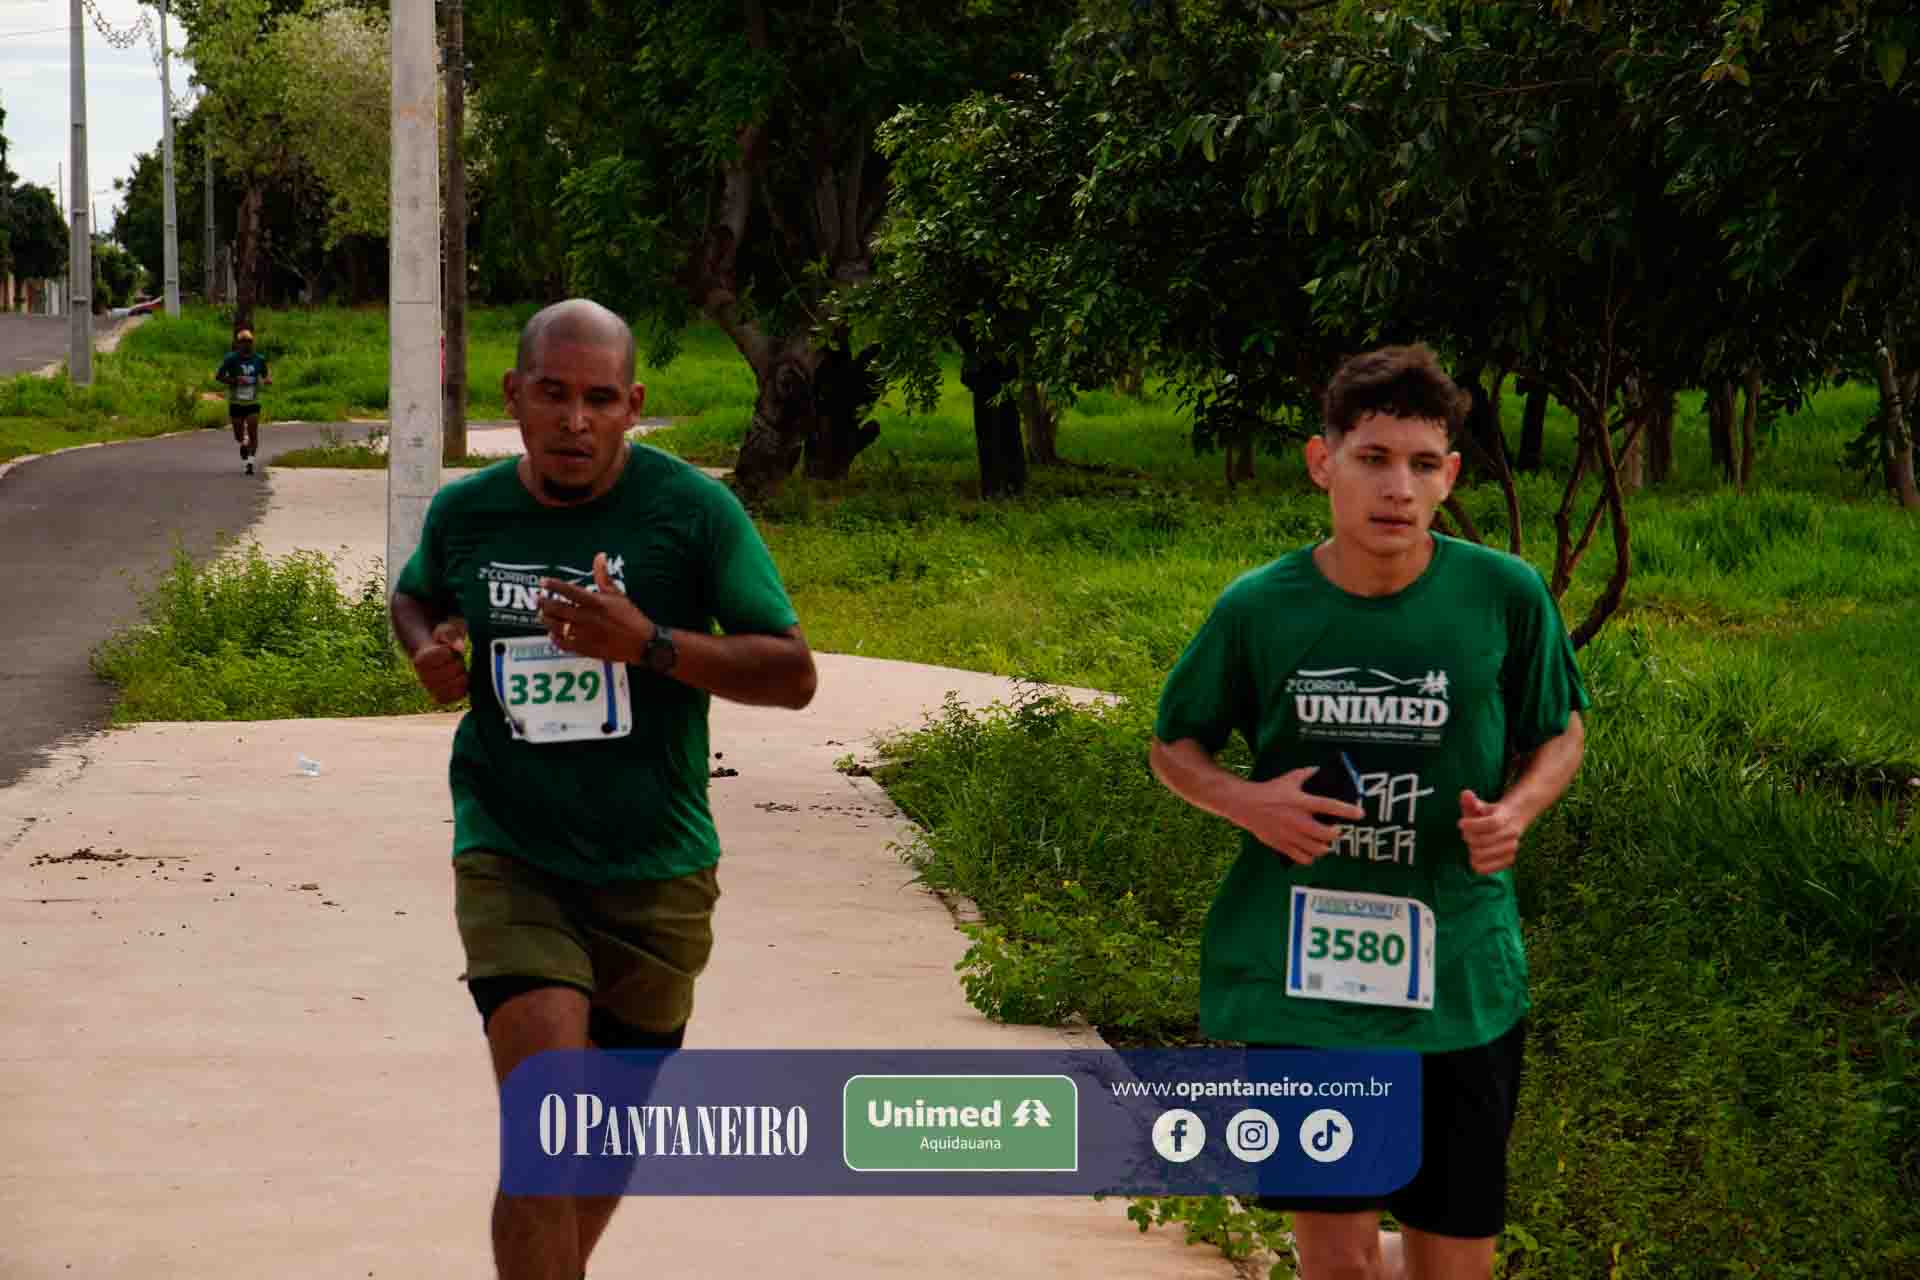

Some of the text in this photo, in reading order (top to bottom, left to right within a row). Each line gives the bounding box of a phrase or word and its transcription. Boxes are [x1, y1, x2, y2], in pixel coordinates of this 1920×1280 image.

[510, 671, 601, 705] 3329
[1295, 695, 1449, 727] UNIMED
[1307, 926, 1405, 966] 3580
